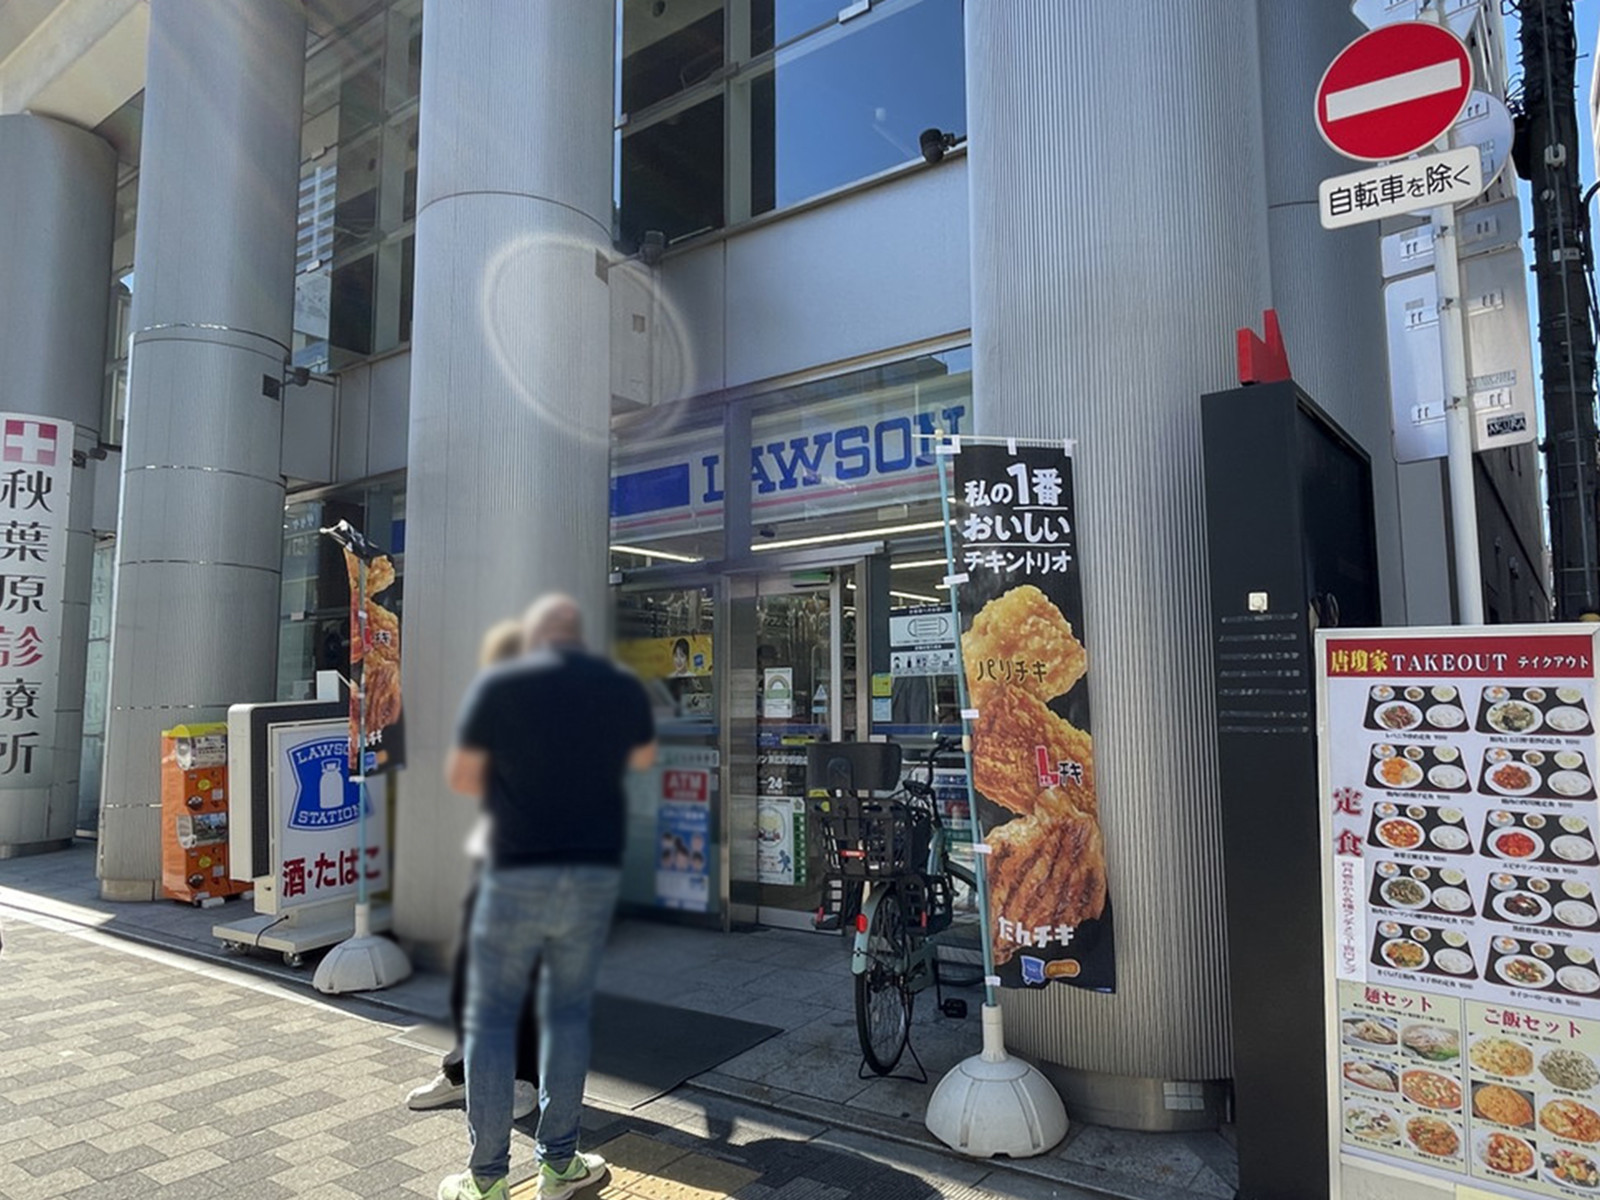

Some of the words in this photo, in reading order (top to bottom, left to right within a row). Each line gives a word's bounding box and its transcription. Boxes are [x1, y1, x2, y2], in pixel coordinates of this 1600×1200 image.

[1329, 163, 1471, 216] 自転車を除く
[702, 405, 966, 503] LAWSON
[964, 462, 1063, 507] 私の1番
[962, 512, 1071, 543] おいしい
[963, 550, 1072, 575] チキントリオ
[0, 469, 52, 774] 秋葉原診療所
[976, 658, 1049, 684] パリチキ
[1392, 653, 1508, 672] TAKEOUT
[1517, 655, 1589, 670] テイクアウト
[296, 743, 348, 765] LAWS
[1035, 745, 1083, 787] Lチキ
[1332, 786, 1364, 857] 定食
[1364, 986, 1433, 1013] 麺セット
[1483, 1007, 1583, 1039] ご飯セット
